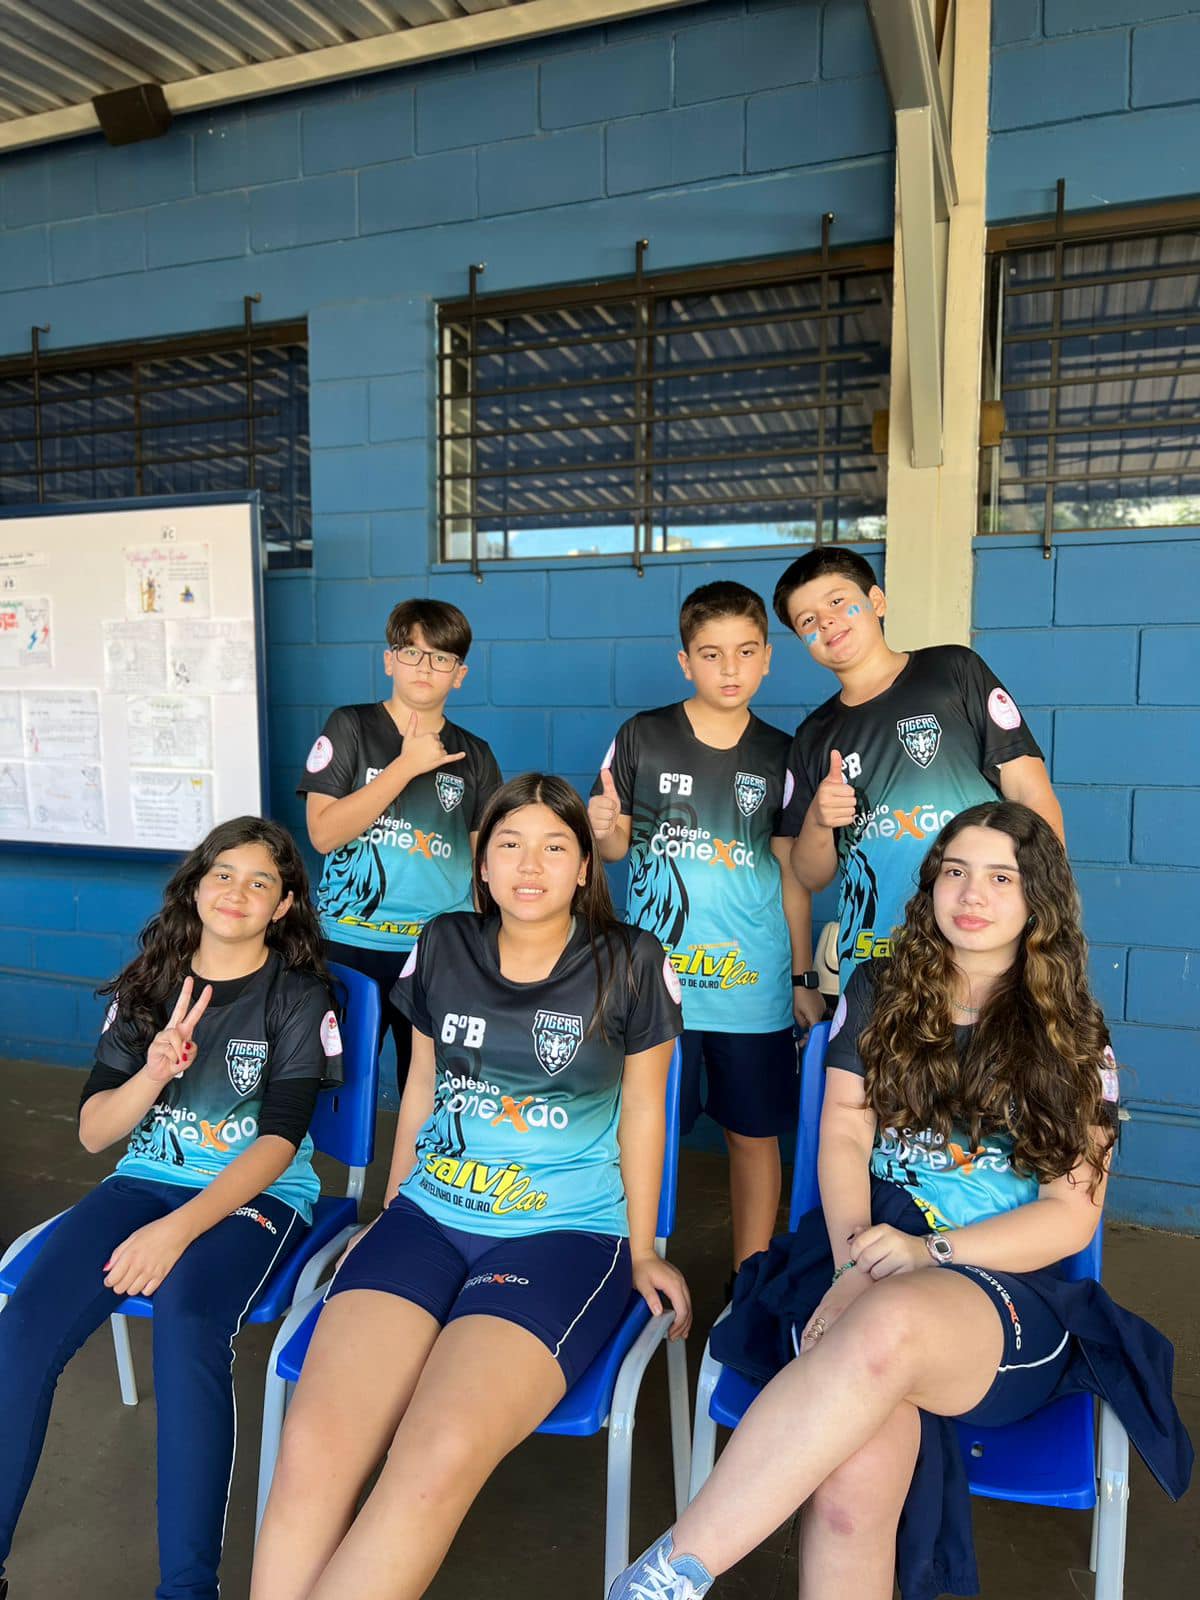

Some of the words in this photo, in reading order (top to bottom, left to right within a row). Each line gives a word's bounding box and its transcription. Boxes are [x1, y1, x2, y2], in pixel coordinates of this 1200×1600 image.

[900, 716, 938, 732] TIGERS
[660, 773, 693, 796] 6ºB
[373, 815, 412, 831] olégio
[660, 822, 710, 840] Colégio
[664, 945, 738, 978] alvi
[441, 1013, 486, 1049] 6ºB
[537, 1012, 580, 1036] TIGERS
[229, 1042, 267, 1058] TIGERS
[453, 1193, 464, 1208] DE
[465, 1197, 491, 1213] OURO
[491, 1176, 549, 1215] Car
